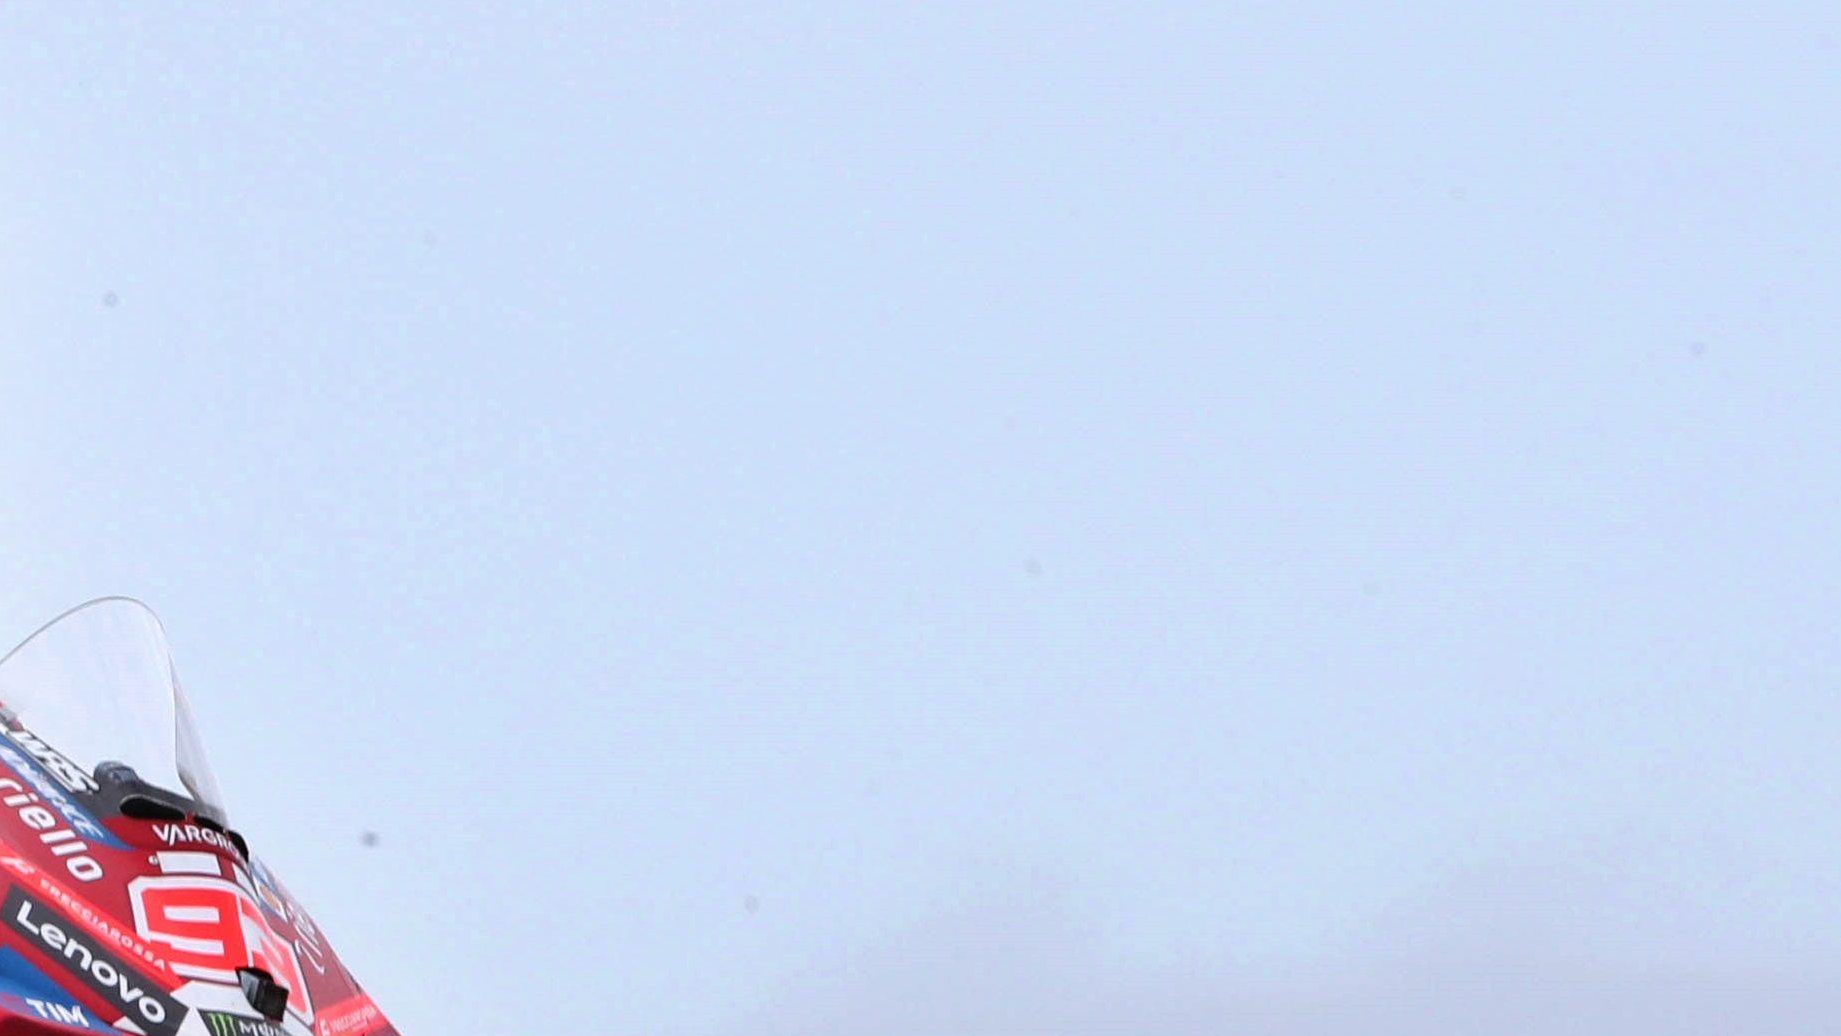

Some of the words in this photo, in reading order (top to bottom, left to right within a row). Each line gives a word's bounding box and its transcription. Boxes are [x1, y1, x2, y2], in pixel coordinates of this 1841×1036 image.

[16, 900, 167, 1025] Lenovo
[39, 878, 167, 973] FRECCIAROSSA
[25, 997, 91, 1029] TIM
